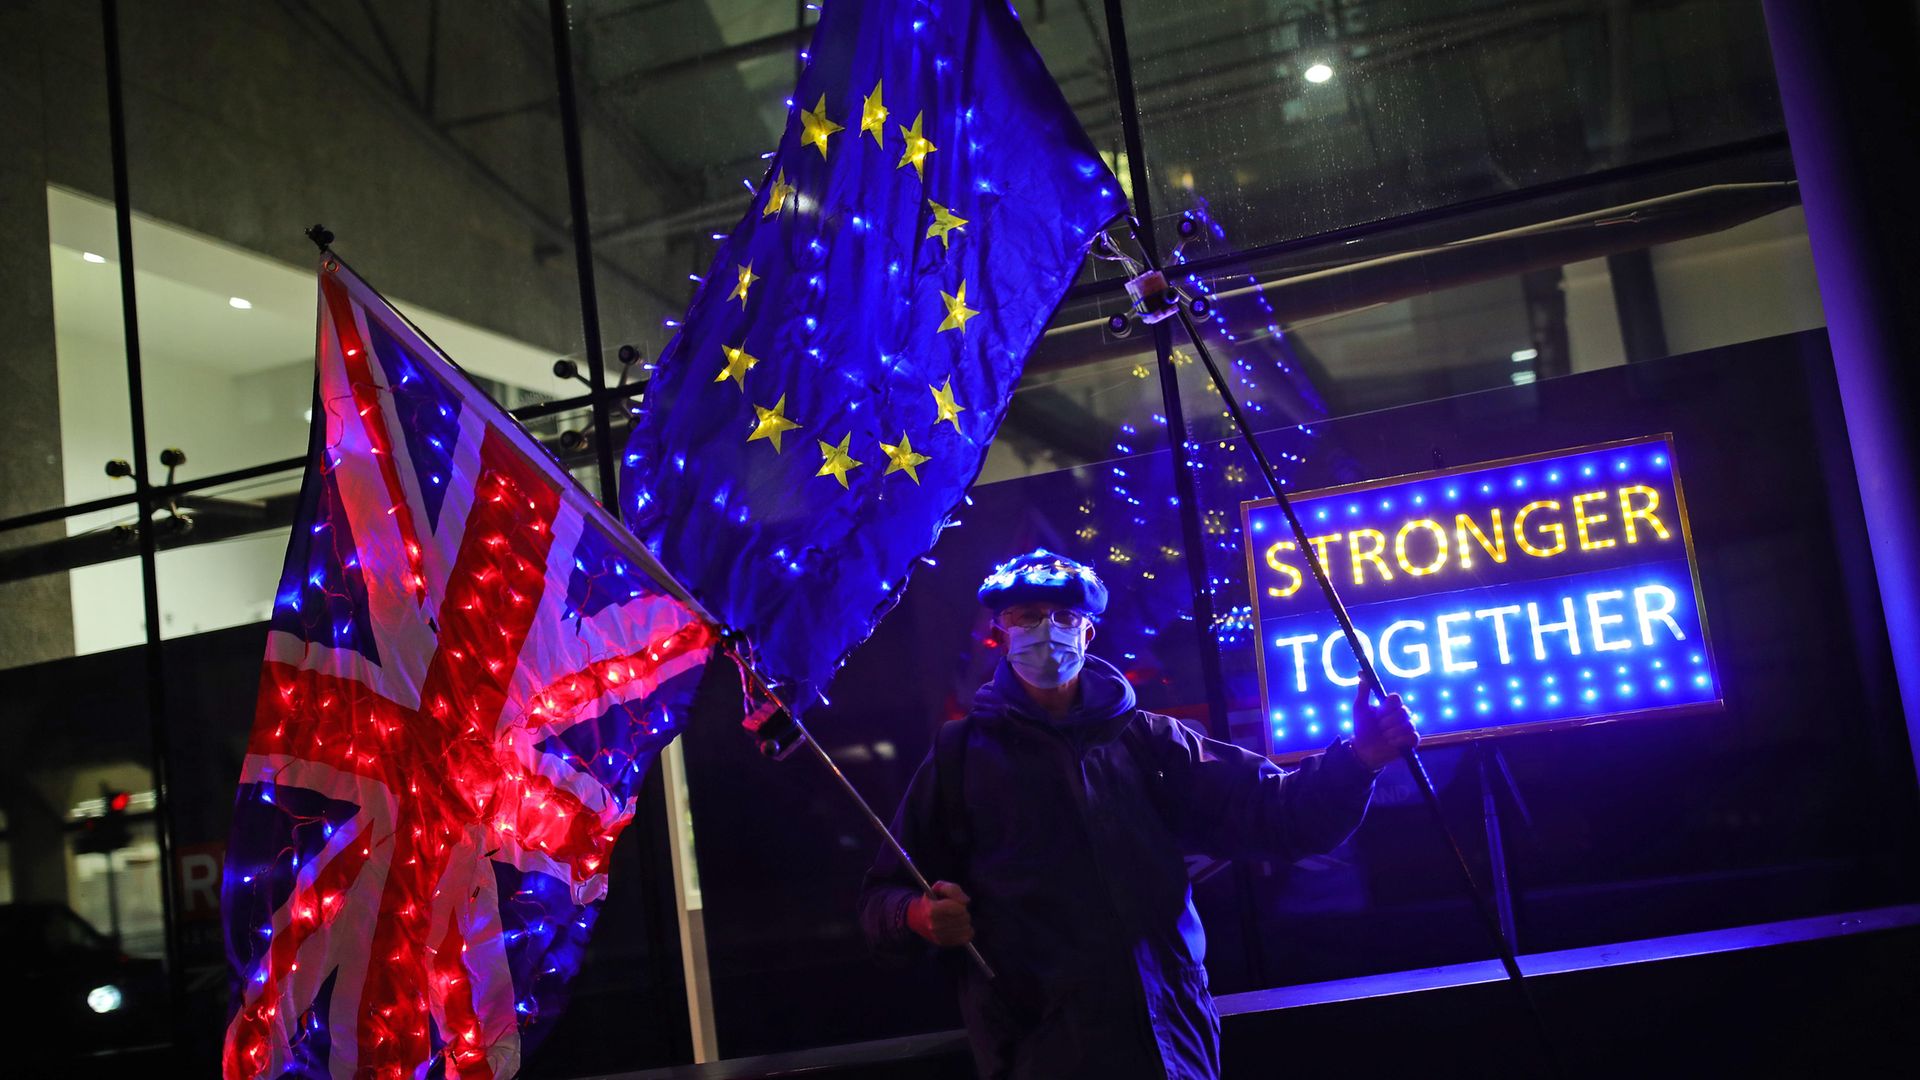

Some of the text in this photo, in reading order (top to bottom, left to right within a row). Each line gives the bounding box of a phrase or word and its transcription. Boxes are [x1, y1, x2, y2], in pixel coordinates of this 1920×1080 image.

[1265, 485, 1671, 597] STRONGER
[1275, 584, 1686, 692] TOGETHER
[181, 852, 225, 913] R
